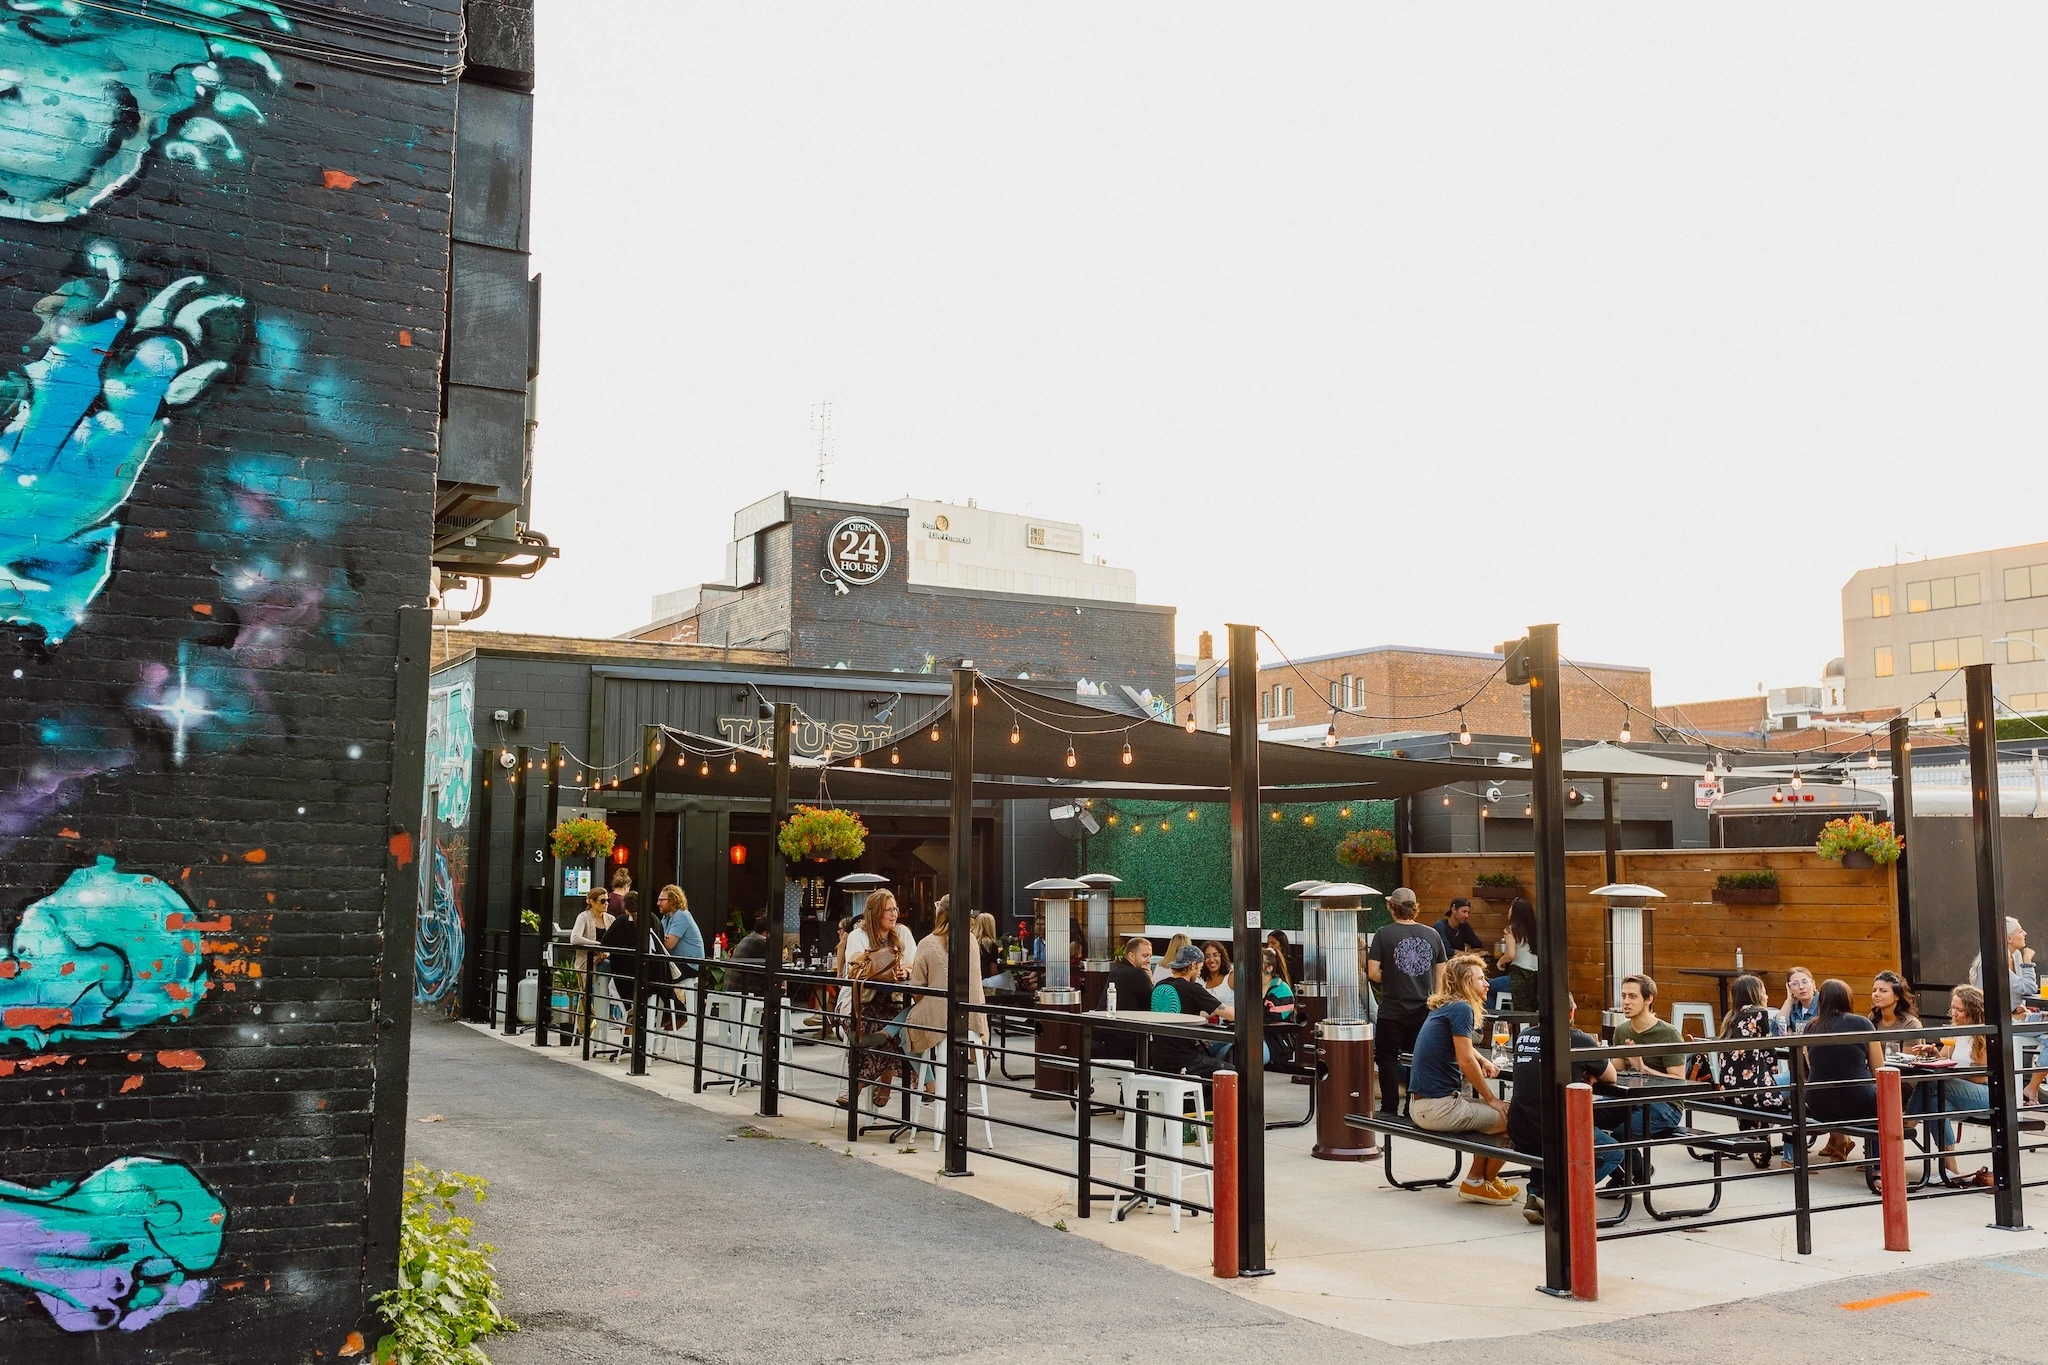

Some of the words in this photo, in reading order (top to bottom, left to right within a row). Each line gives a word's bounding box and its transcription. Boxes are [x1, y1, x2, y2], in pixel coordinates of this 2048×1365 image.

[848, 523, 871, 532] OPEN
[840, 531, 879, 563] 24
[841, 560, 878, 573] HOURS
[534, 849, 544, 863] 3
